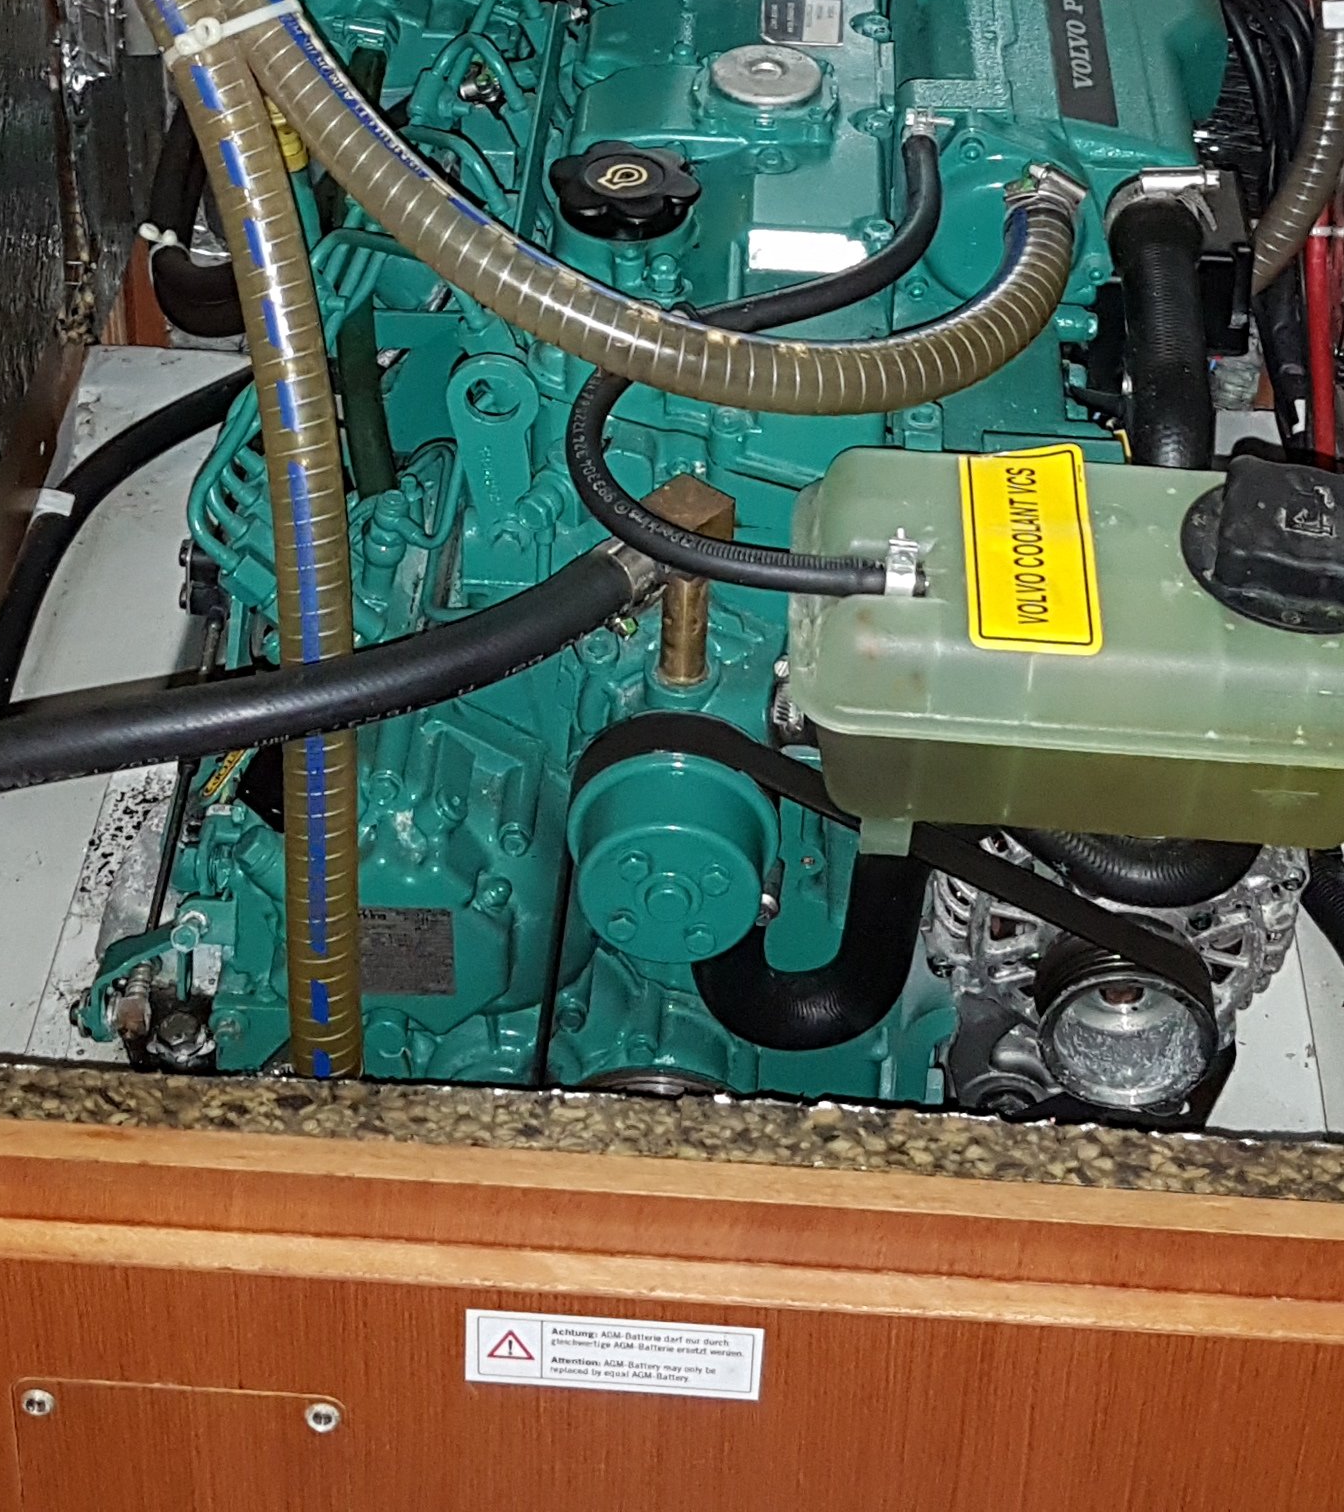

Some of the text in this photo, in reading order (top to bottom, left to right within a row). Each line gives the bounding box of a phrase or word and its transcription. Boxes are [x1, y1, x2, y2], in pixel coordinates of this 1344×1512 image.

[1066, 19, 1094, 89] VOLVO
[1005, 467, 1049, 624] VOLVO COOLANT VCS
[552, 1328, 598, 1339] Achtung:
